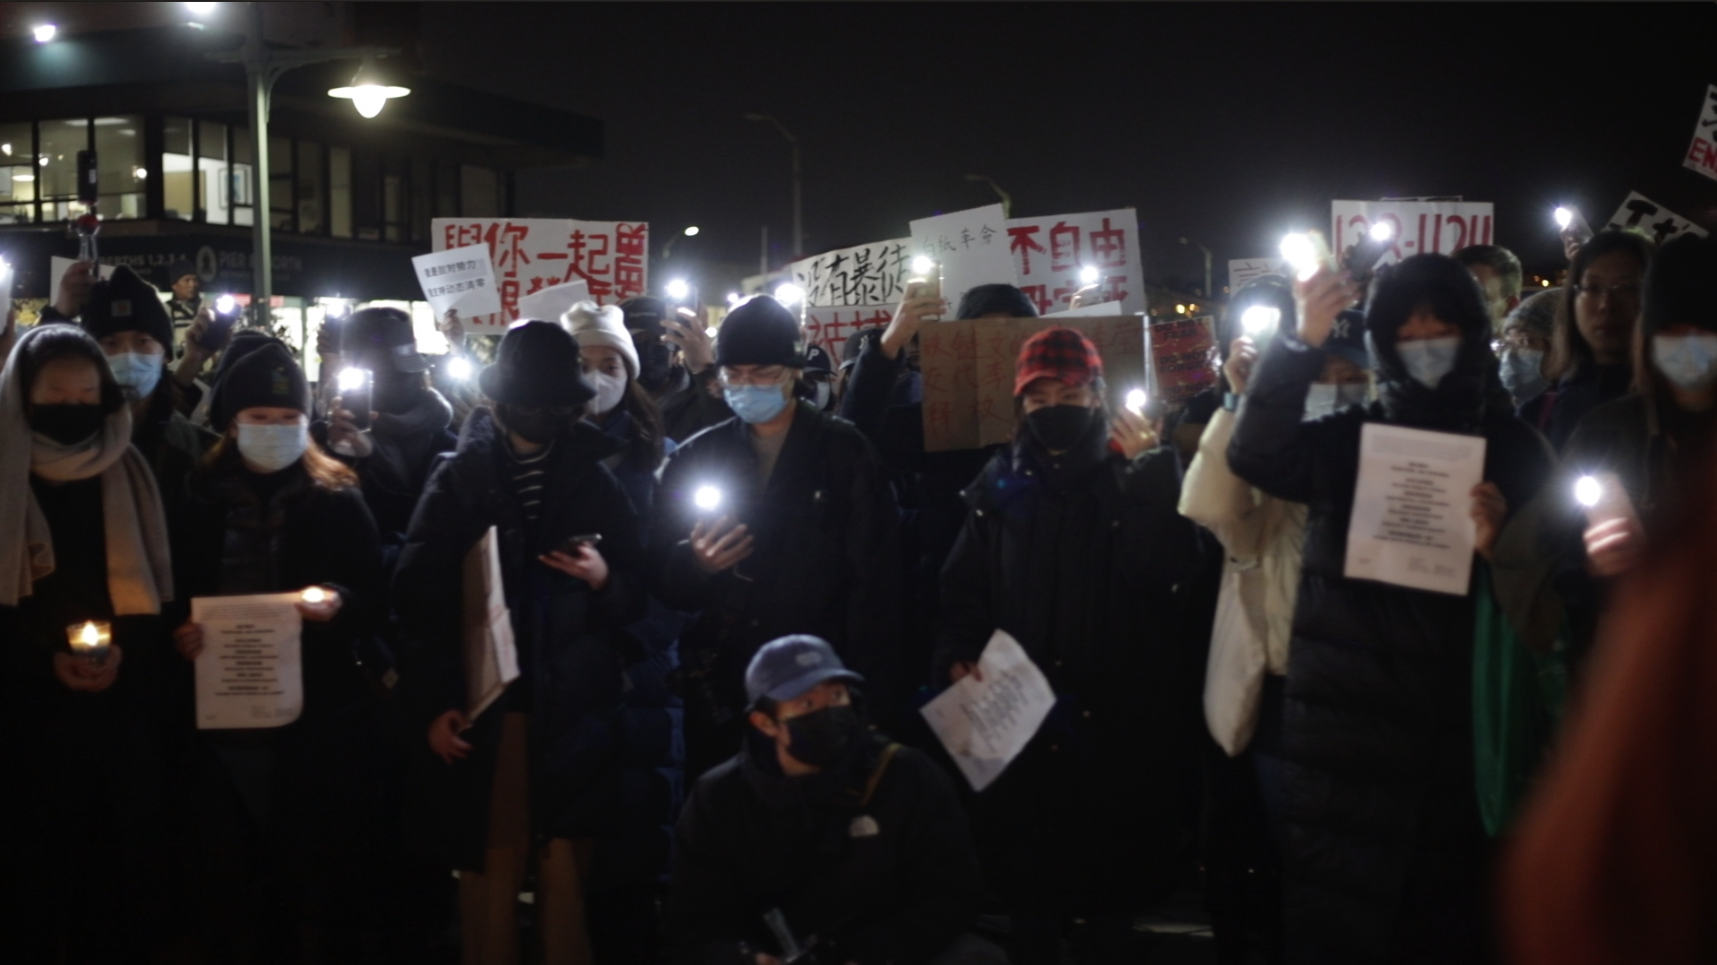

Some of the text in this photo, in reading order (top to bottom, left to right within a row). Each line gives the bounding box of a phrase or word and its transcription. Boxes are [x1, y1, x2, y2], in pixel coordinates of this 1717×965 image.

[1007, 217, 1127, 274] 不自由
[1155, 323, 1171, 332] DO
[1165, 328, 1197, 340] FEAR
[1160, 355, 1177, 365] DO
